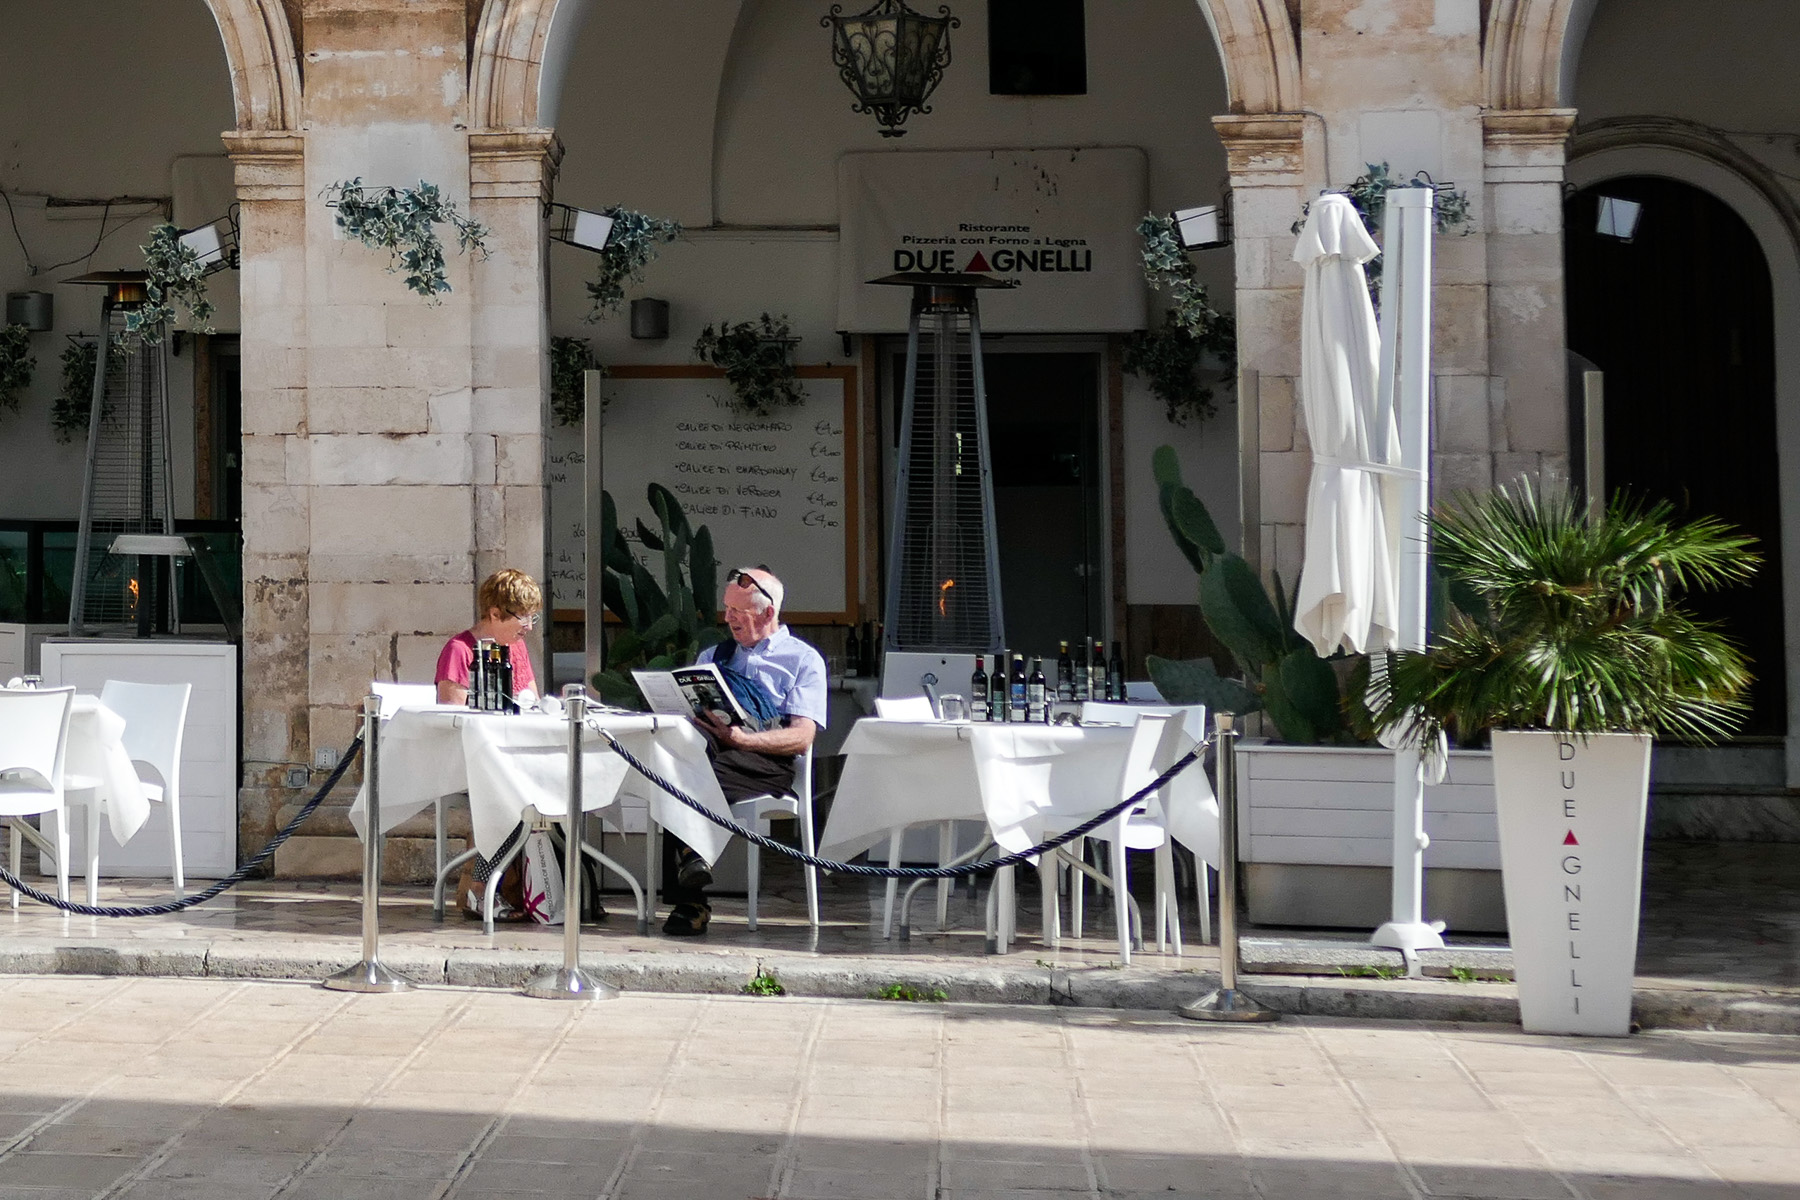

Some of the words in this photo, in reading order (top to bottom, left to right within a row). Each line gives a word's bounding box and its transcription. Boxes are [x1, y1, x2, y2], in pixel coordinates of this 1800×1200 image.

[959, 223, 1030, 233] Ristorante
[902, 235, 957, 245] Pizzeria
[960, 237, 984, 245] con
[989, 236, 1029, 245] Forno
[1033, 238, 1041, 246] a
[1046, 237, 1087, 248] Legna
[894, 250, 955, 272] DUE
[1559, 742, 1576, 818] DUE
